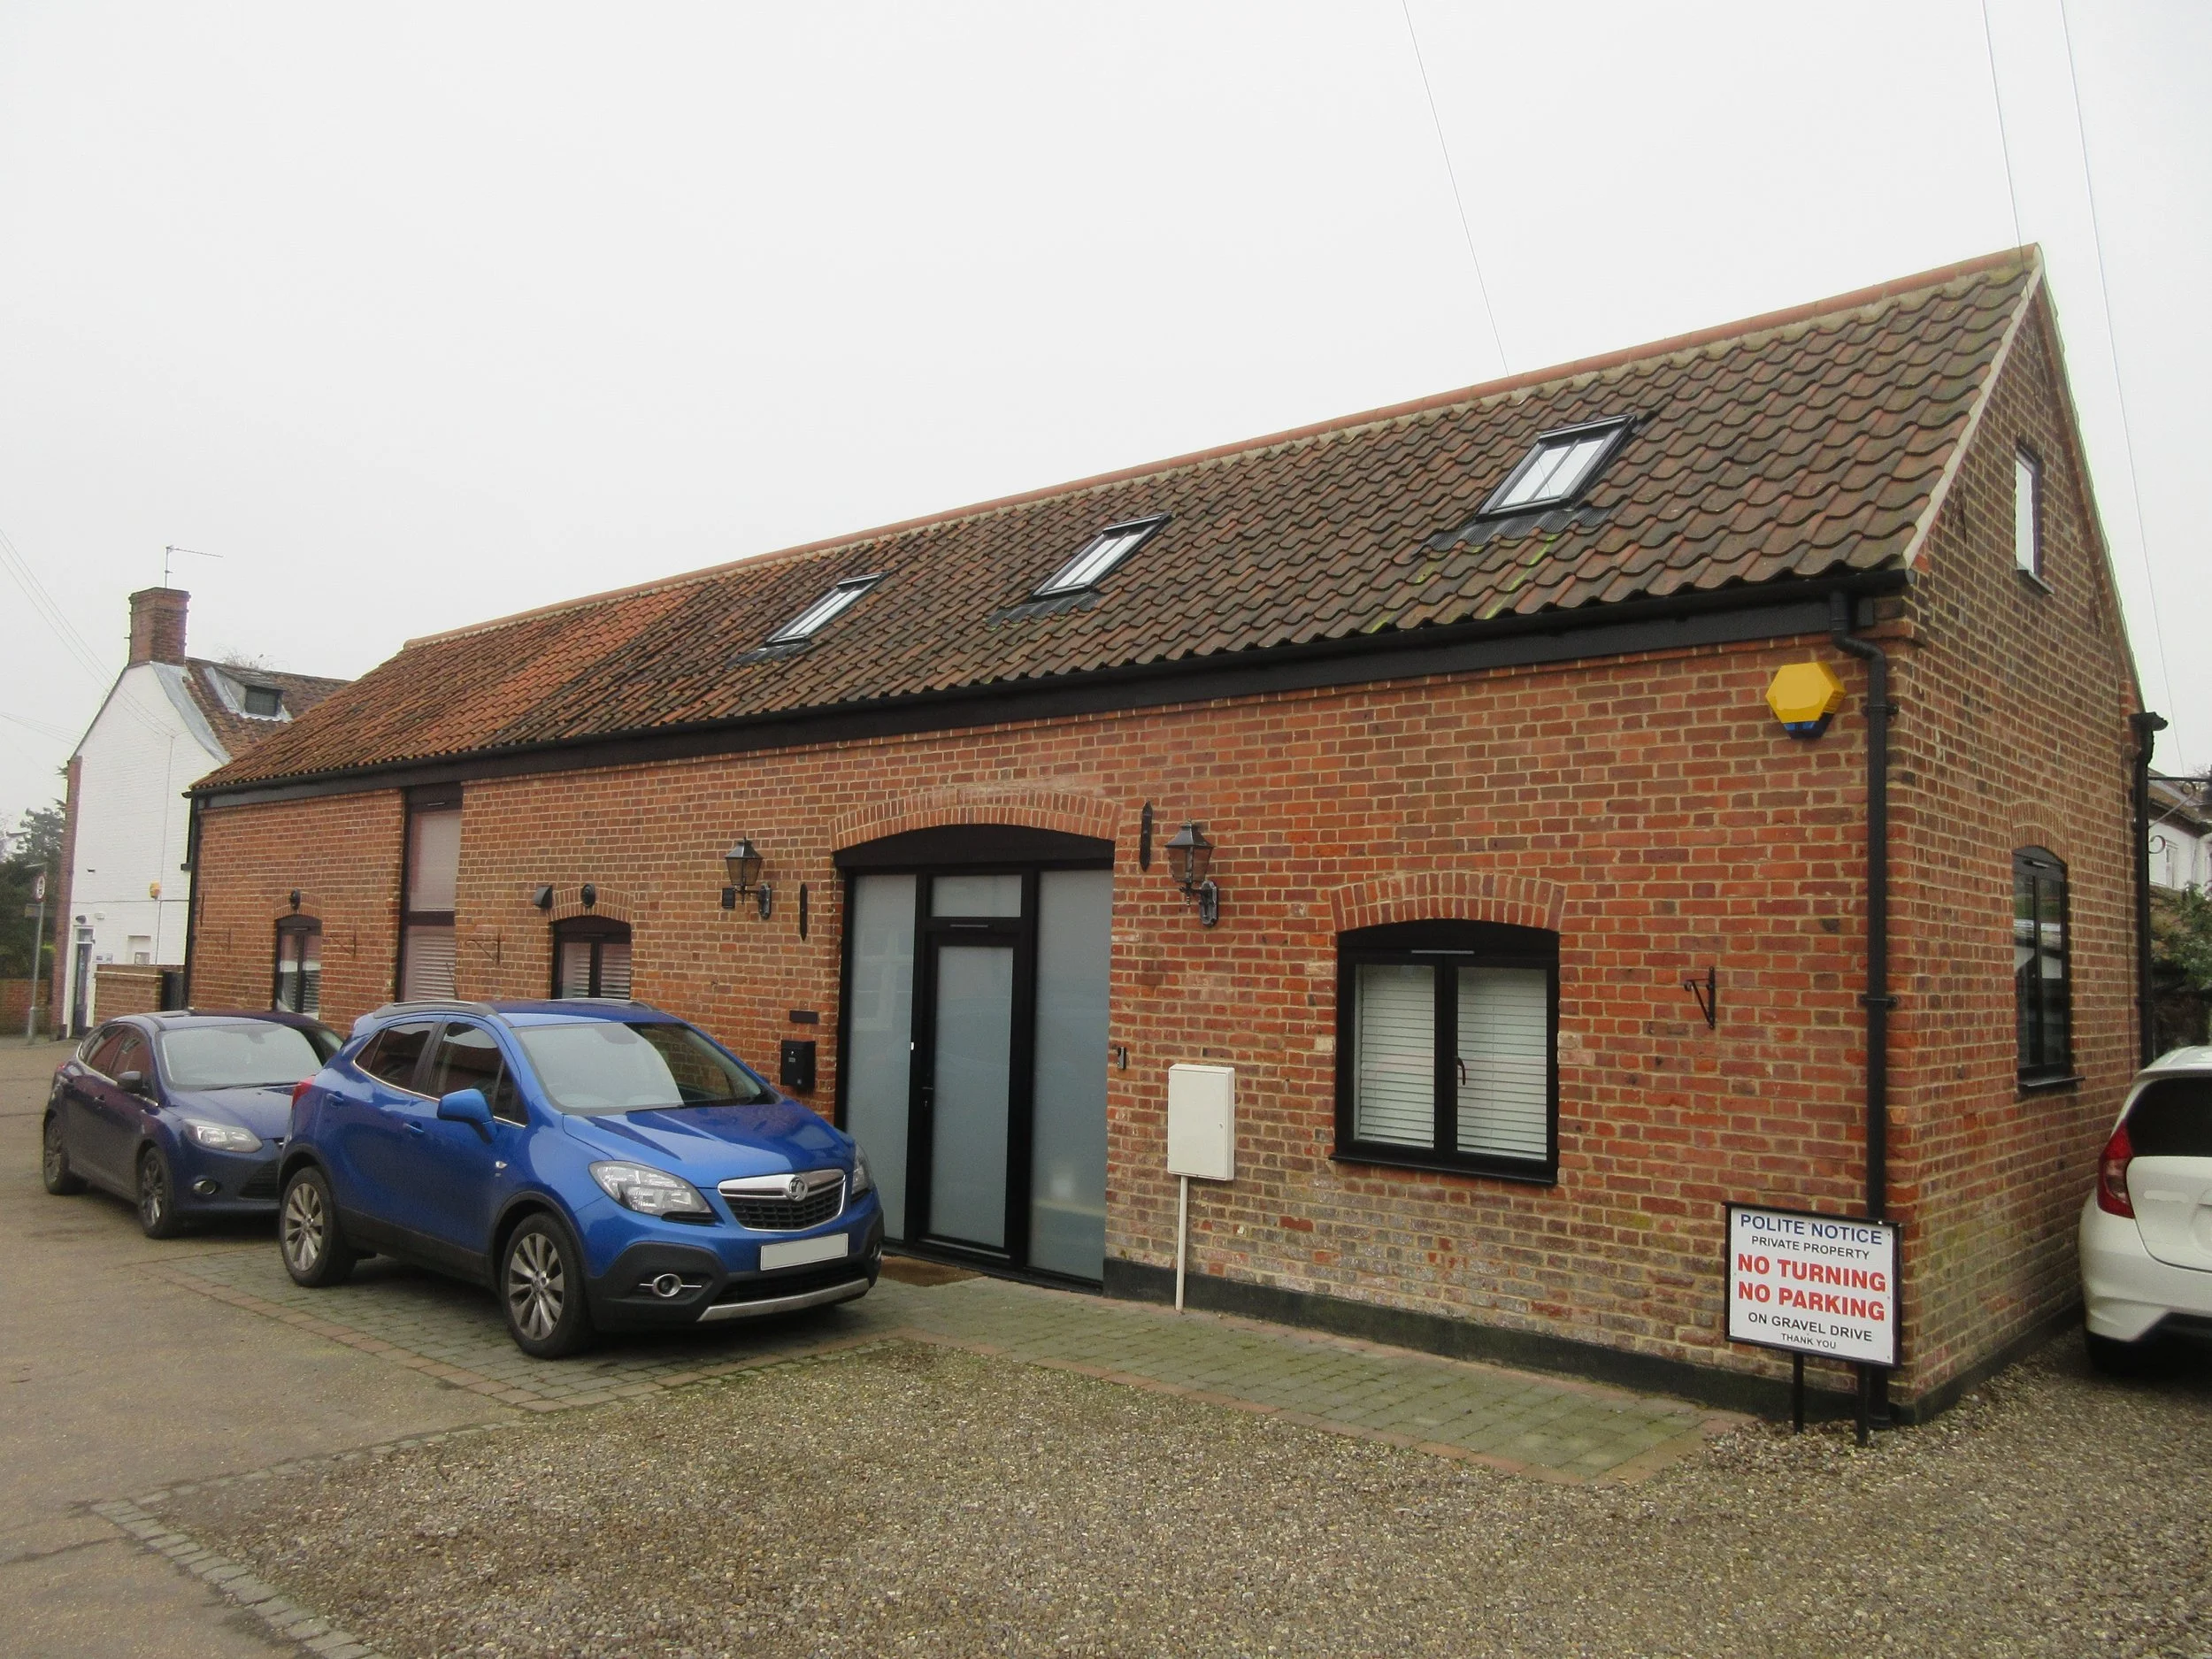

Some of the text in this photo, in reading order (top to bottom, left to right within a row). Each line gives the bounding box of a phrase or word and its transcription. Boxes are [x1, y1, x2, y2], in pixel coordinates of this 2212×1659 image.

[1740, 1213, 1882, 1245] POLITE NOTICE
[1752, 1235, 1870, 1260] PRIVATE PROPERTY
[1738, 1253, 1886, 1292] NO TURNING
[1738, 1280, 1885, 1321] NO PARKING
[1748, 1311, 1872, 1342] ON GRAVEL DRIVE
[1781, 1333, 1837, 1349] THANK YOU
